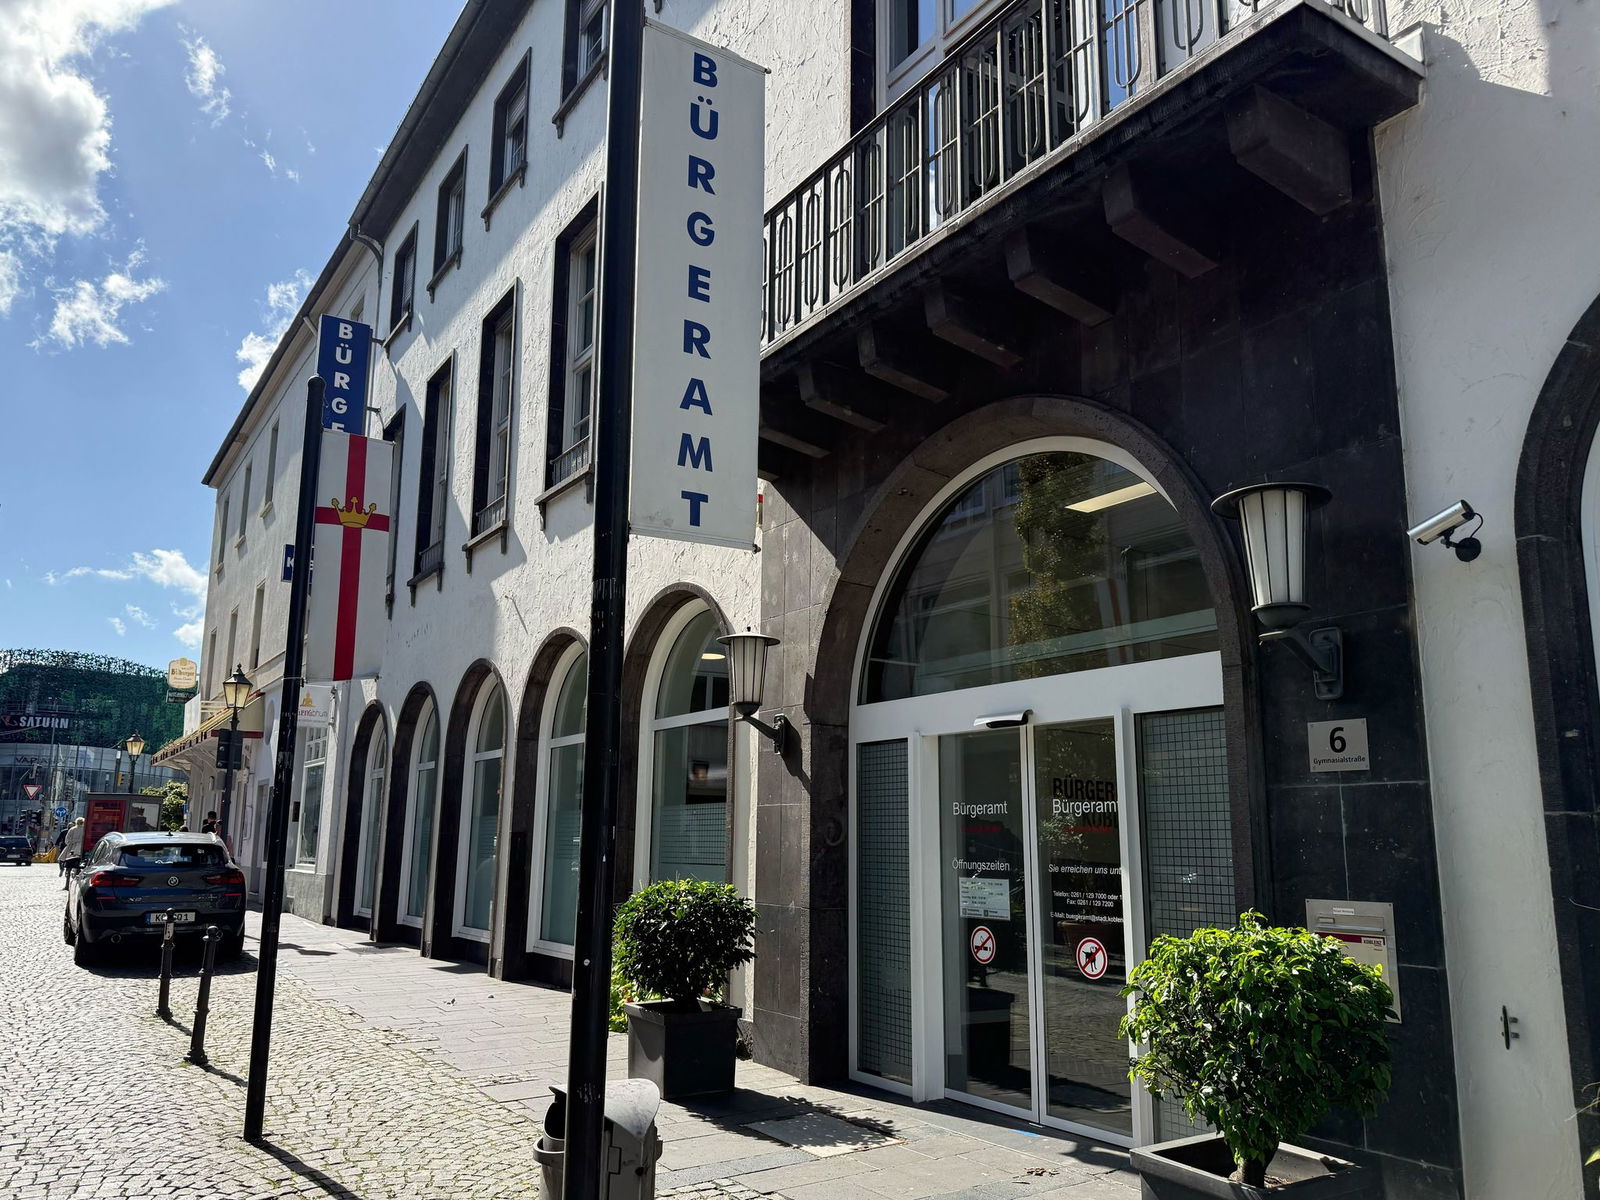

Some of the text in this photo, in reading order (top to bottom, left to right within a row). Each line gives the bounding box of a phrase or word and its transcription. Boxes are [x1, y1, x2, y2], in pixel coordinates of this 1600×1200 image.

[677, 51, 719, 527] BÜRGERAMT
[19, 716, 69, 729] SATURN
[1329, 726, 1347, 753] 6
[1313, 755, 1366, 766] Gymnasialstraße
[952, 800, 1008, 819] Bürgeramt
[952, 857, 1010, 873] Öffnungszeiten
[1048, 864, 1059, 873] Sie
[1060, 865, 1093, 874] erreichen
